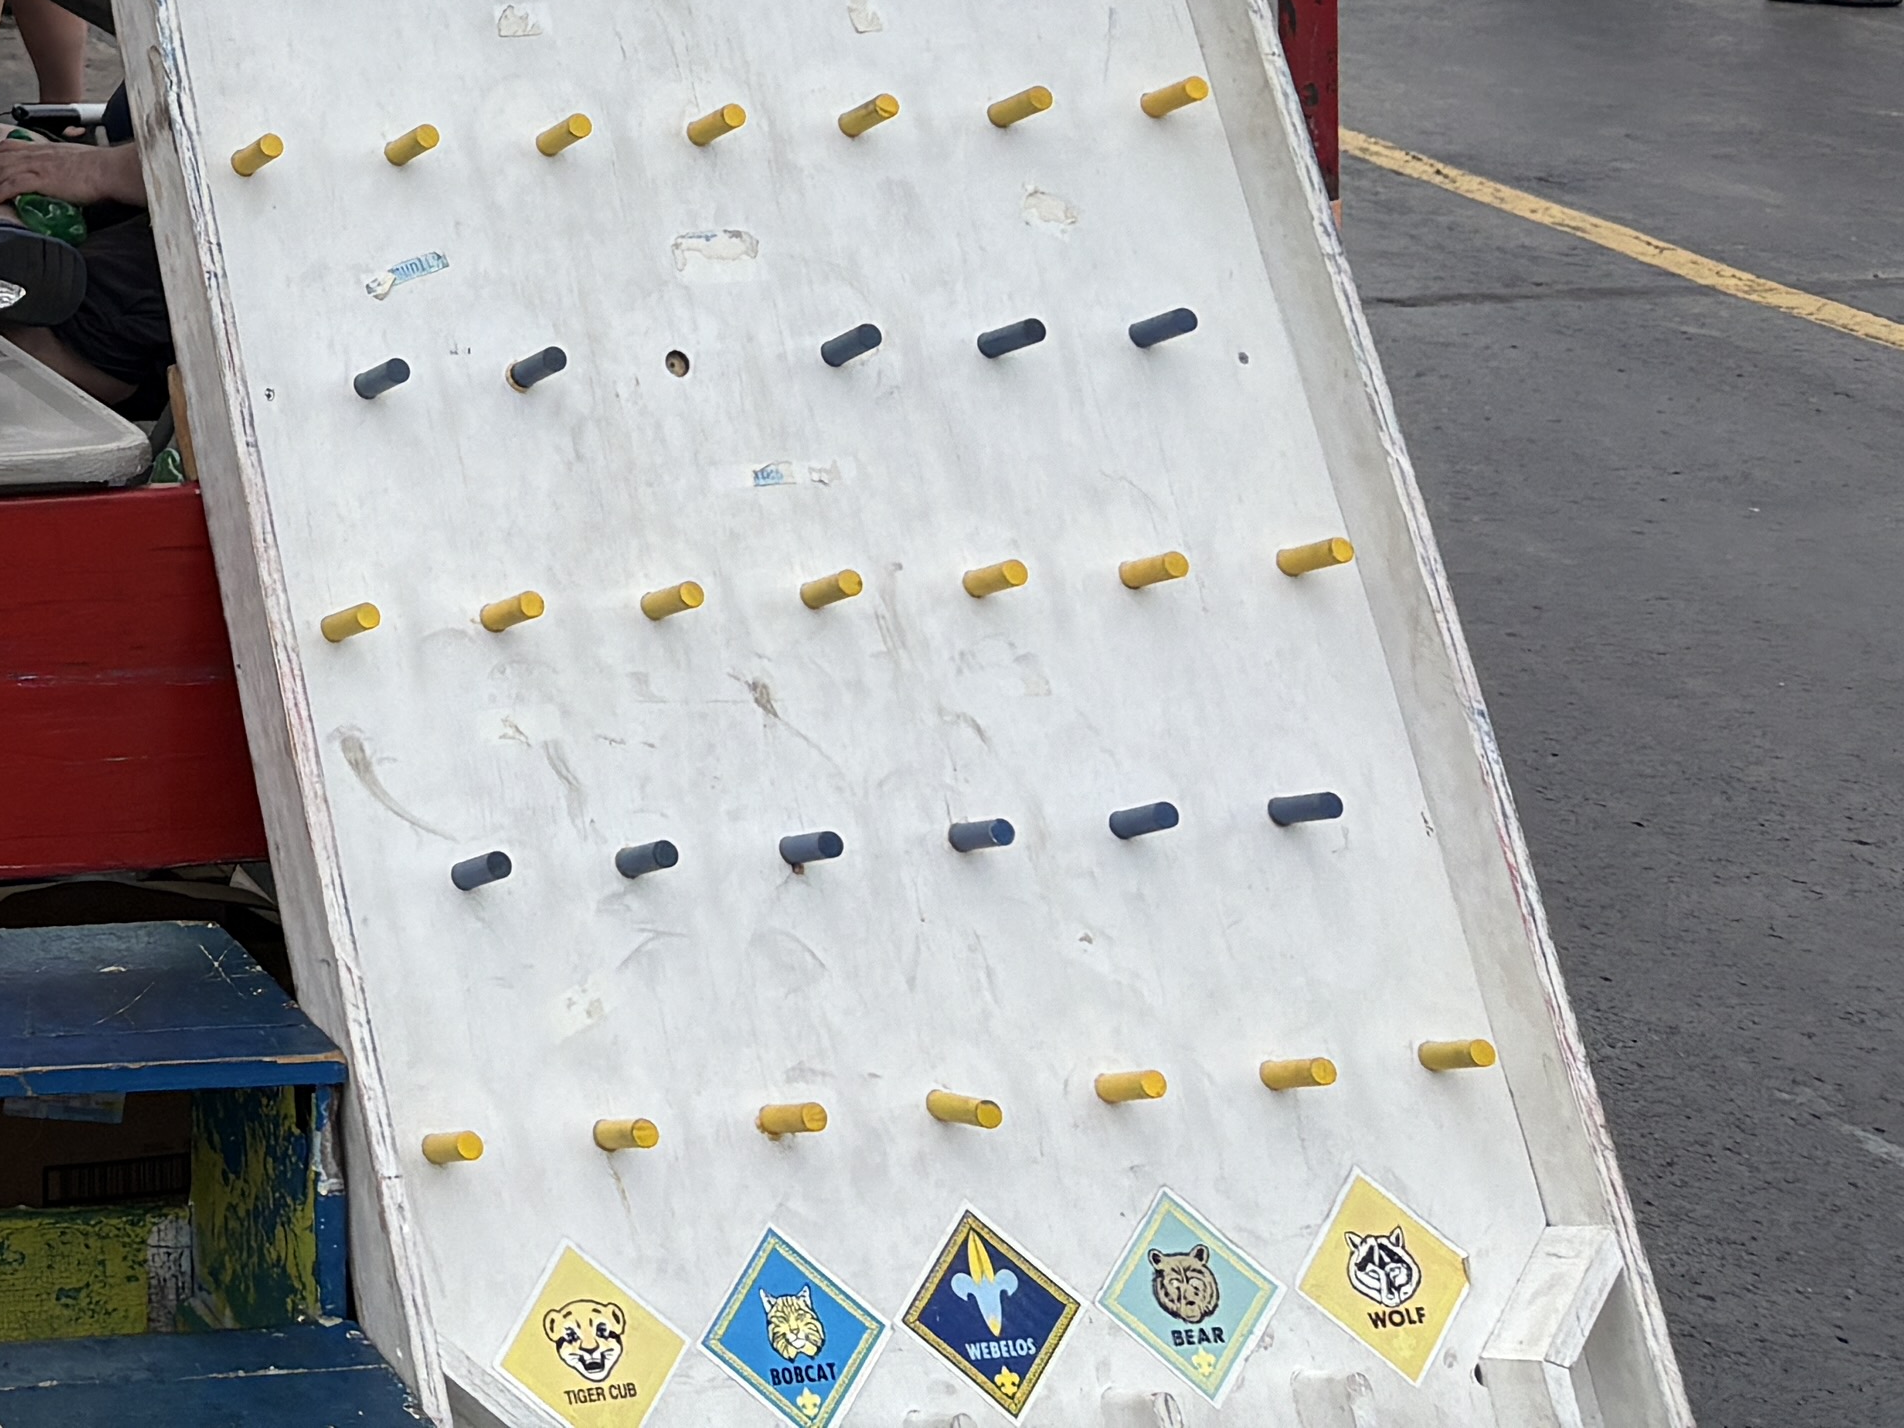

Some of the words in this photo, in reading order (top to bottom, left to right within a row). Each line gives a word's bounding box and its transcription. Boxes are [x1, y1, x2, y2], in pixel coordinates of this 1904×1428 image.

[1368, 1307, 1427, 1330] WOLF
[1172, 1327, 1226, 1347] BEAR
[965, 1337, 1036, 1361] WEBELOS
[769, 1362, 837, 1386] BOBCAT
[564, 1387, 606, 1406] TIGER
[609, 1383, 638, 1401] CUB
